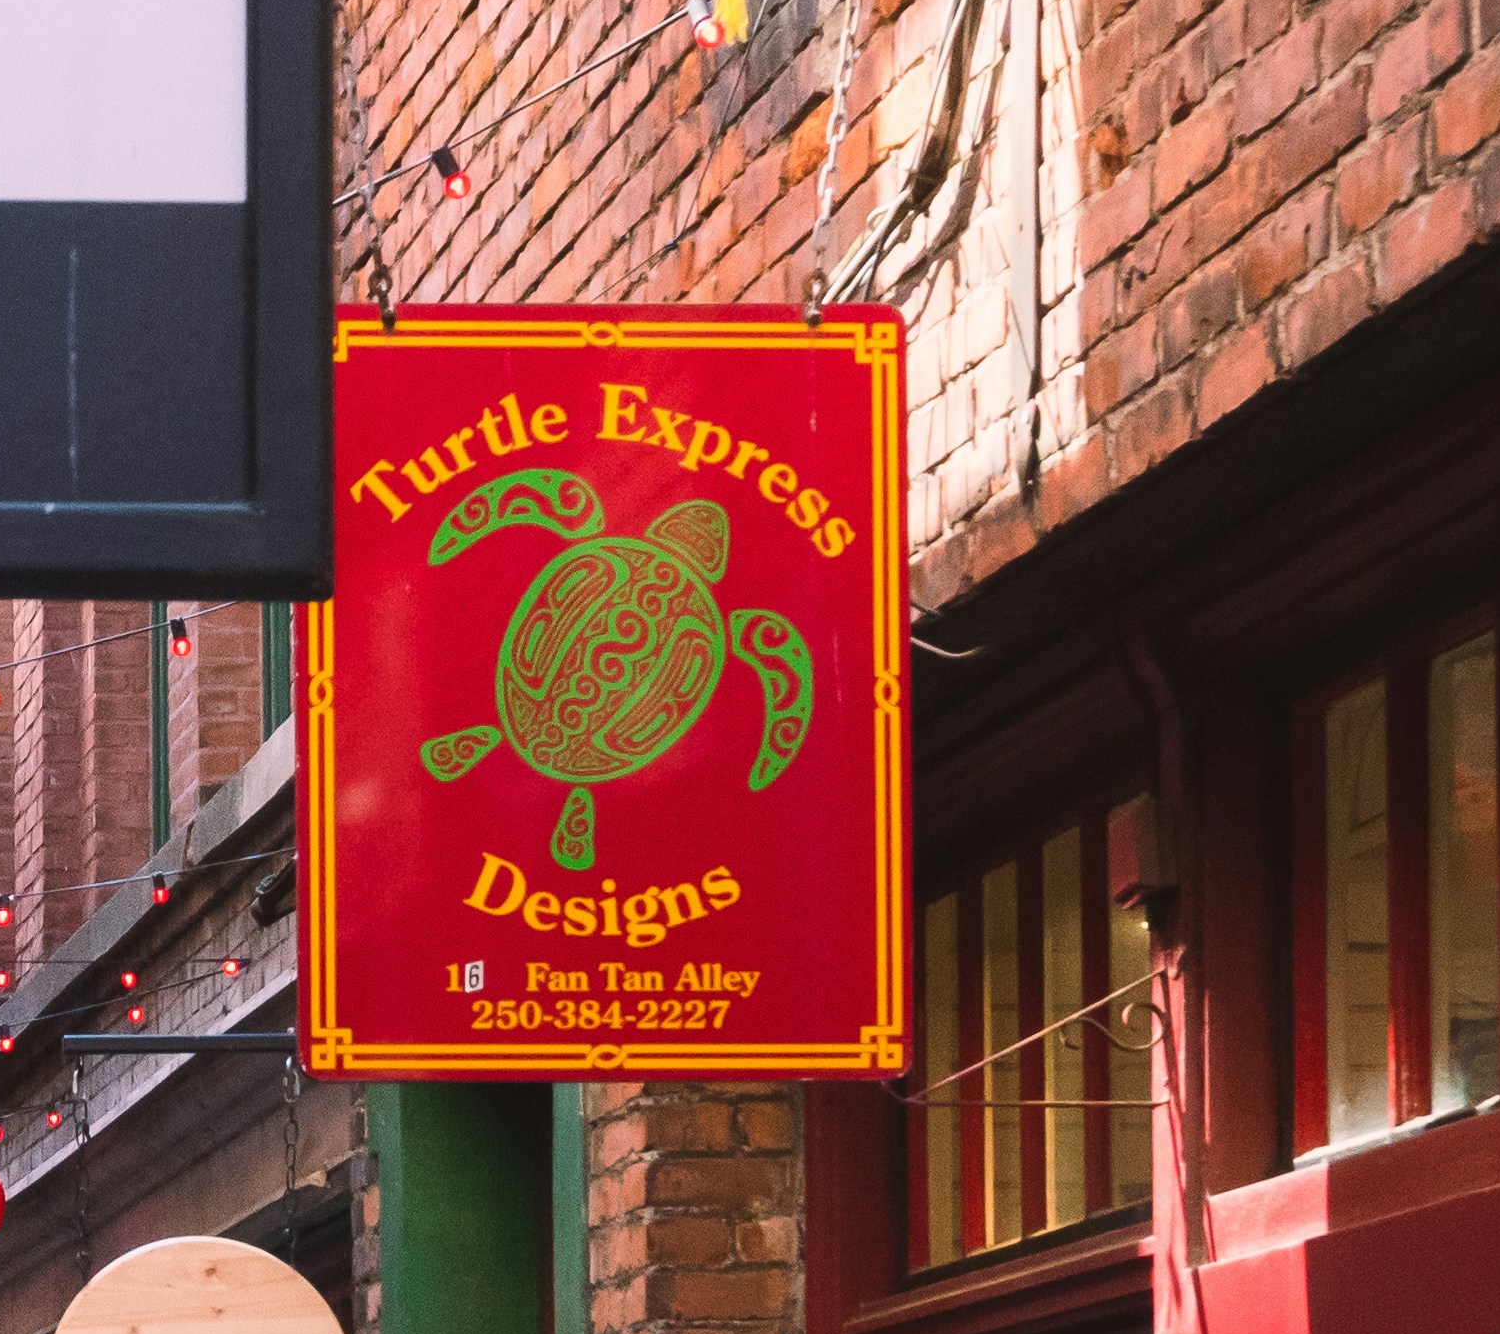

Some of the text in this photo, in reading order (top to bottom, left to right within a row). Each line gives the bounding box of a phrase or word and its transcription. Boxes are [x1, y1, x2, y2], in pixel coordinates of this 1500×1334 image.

[350, 383, 855, 559] Turtle Express
[463, 852, 742, 949] Designs
[445, 960, 760, 996] 16 Fan Tan Alley
[471, 1000, 729, 1030] 250-384-2227
